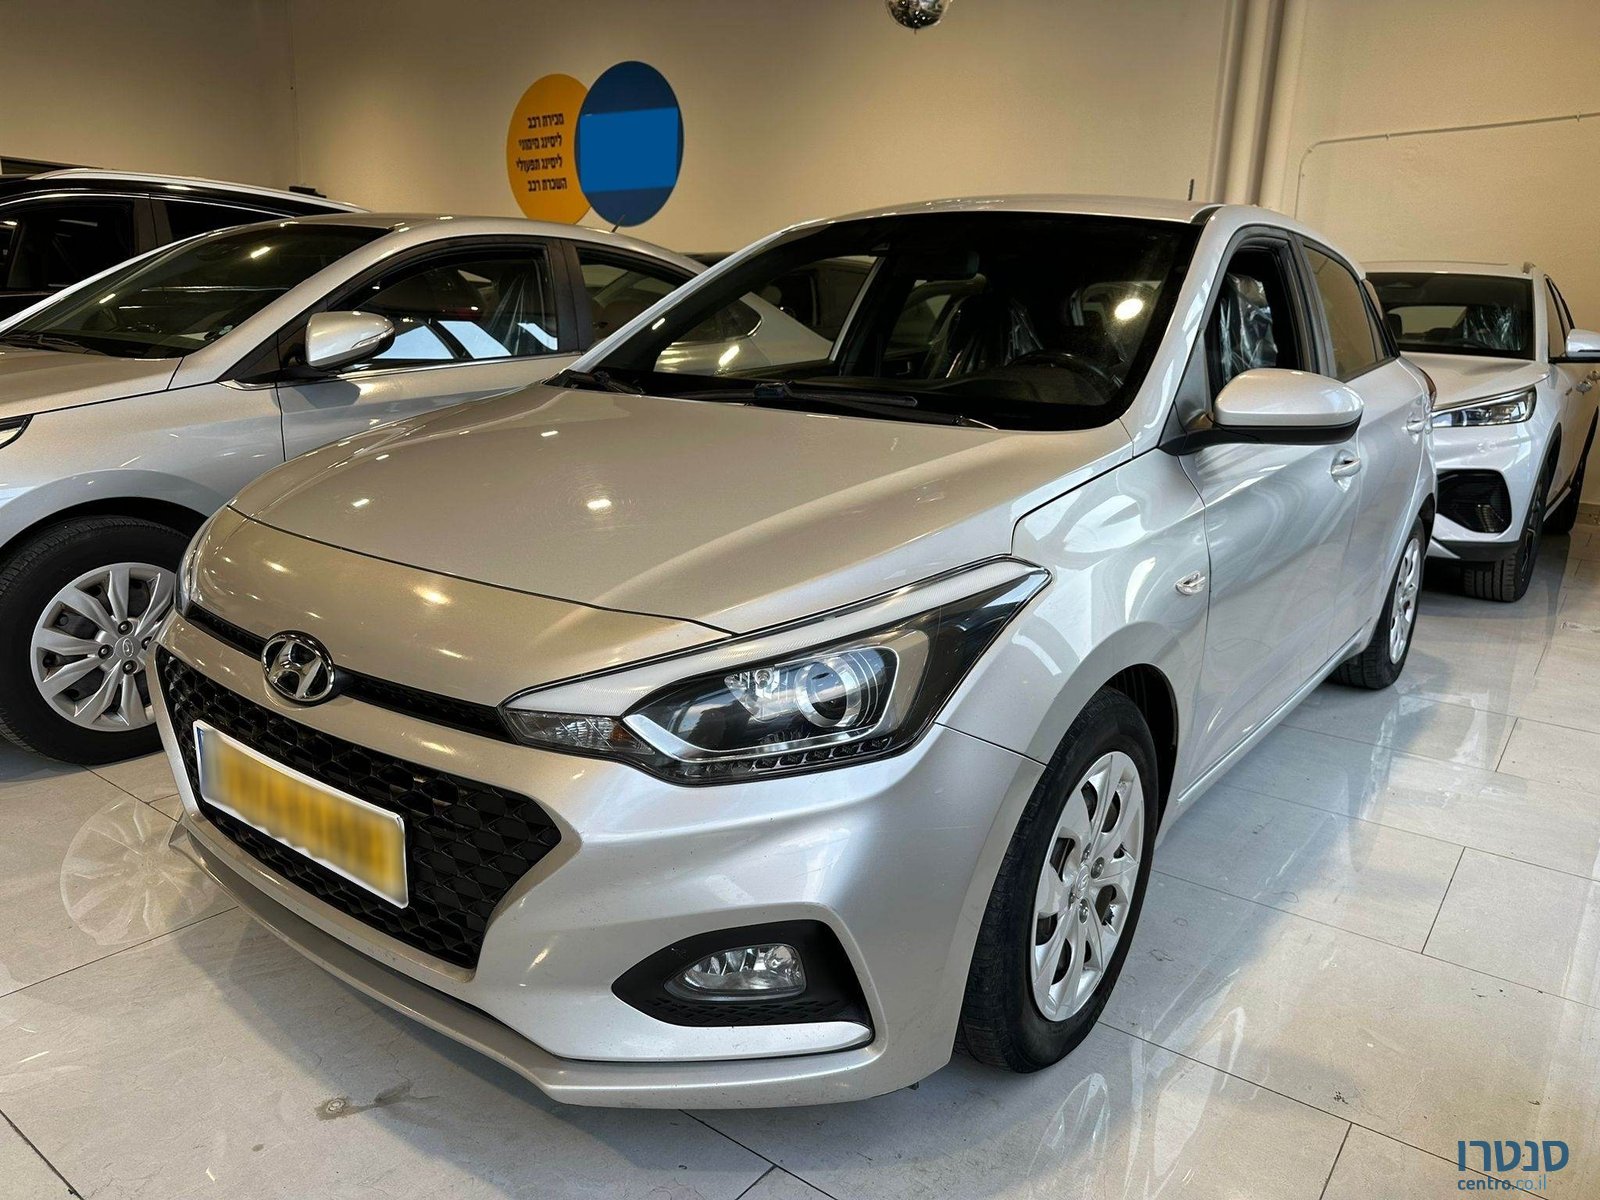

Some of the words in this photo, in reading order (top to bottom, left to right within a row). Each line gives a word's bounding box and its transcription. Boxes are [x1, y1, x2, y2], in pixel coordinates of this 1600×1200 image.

[527, 116, 541, 129] רכב
[542, 112, 564, 127] מכירת
[541, 132, 562, 149] ליסינג
[515, 157, 540, 173] תפעולי
[541, 153, 562, 169] ליסינג
[528, 180, 541, 192] רכב
[542, 177, 568, 191] השכרת
